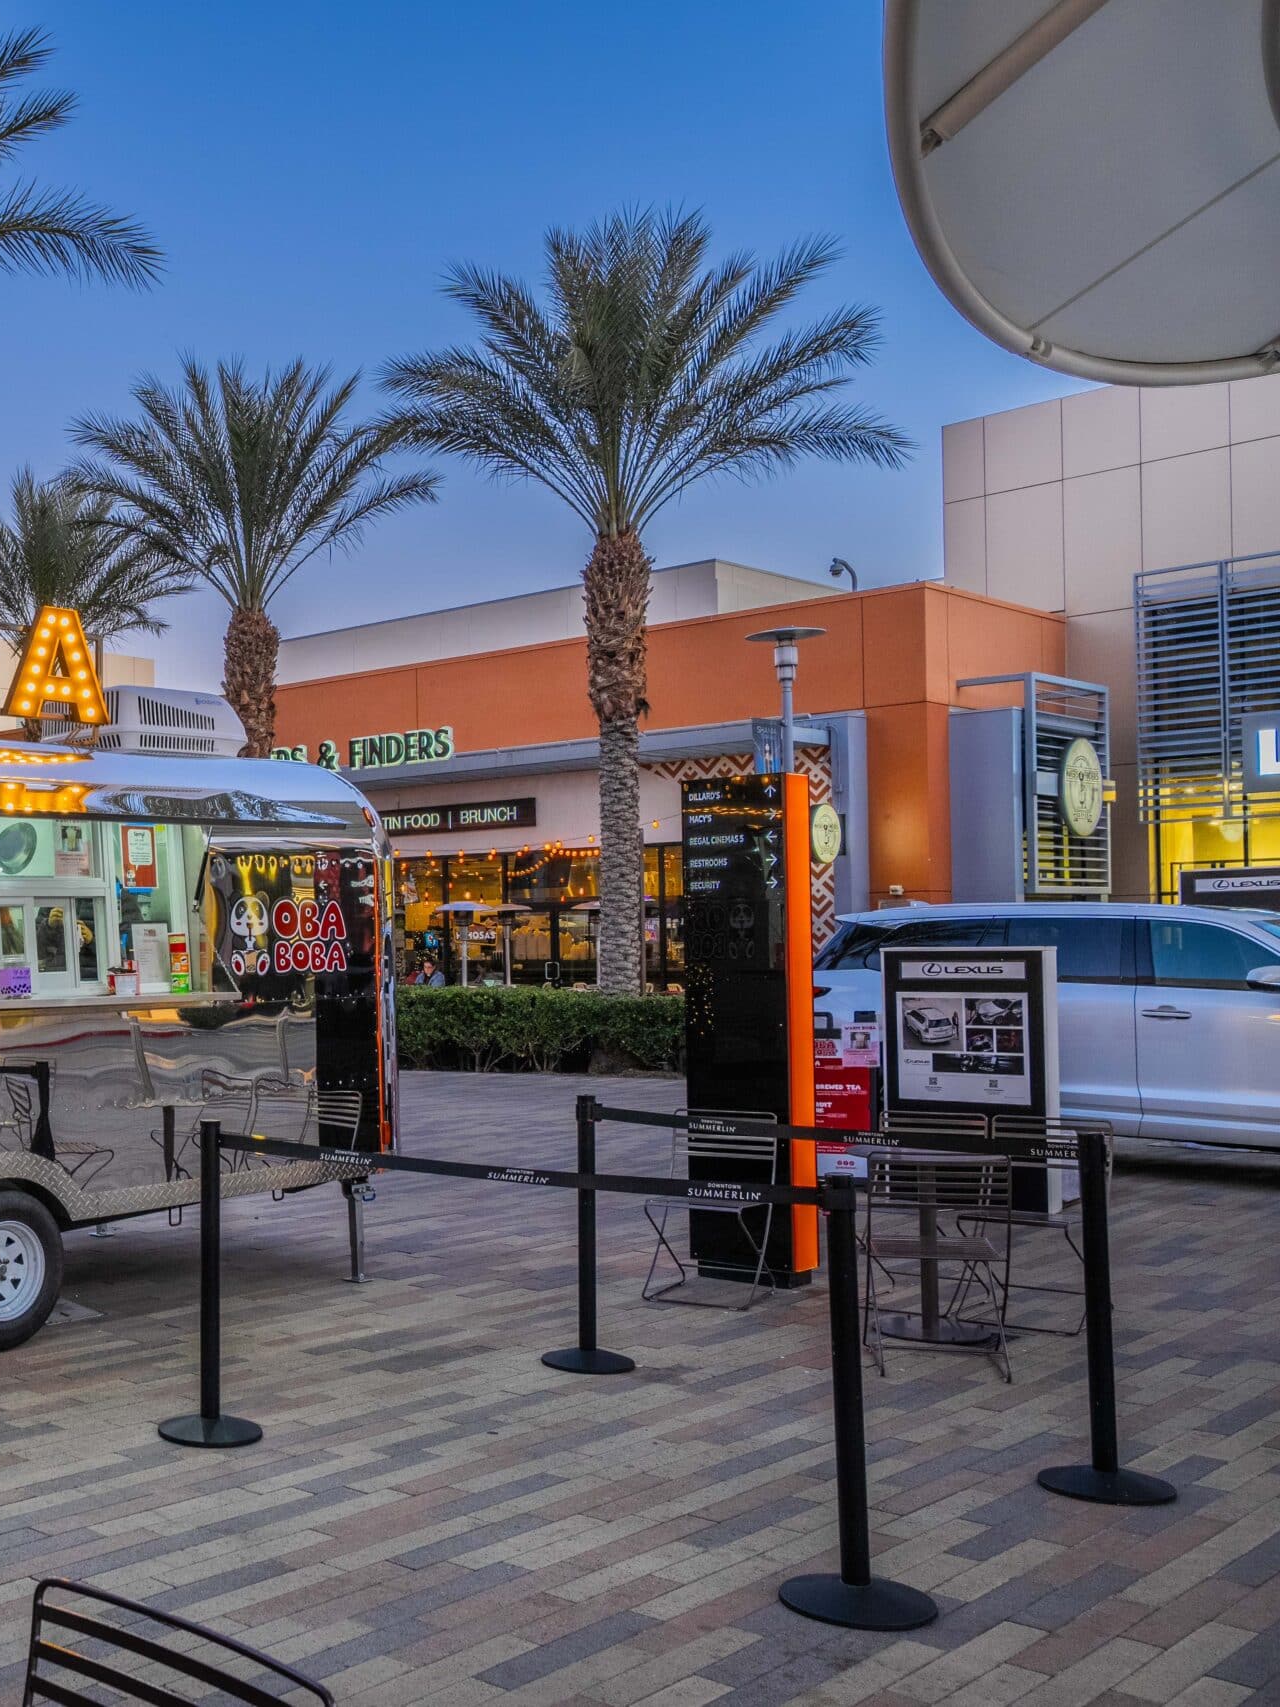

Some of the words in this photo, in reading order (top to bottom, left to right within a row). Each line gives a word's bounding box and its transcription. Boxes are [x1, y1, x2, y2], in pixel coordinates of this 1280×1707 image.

[317, 739, 341, 772] &
[348, 725, 454, 771] FINDERS
[688, 791, 721, 802] DILLARD'S
[382, 816, 401, 830] TIN
[404, 813, 440, 829] FOOD
[460, 806, 517, 825] BRUNCH
[689, 814, 713, 824] MACY'S
[689, 837, 711, 846] REGAL
[711, 835, 738, 844] CINEMAS
[690, 858, 728, 868] RESTROOMS
[690, 881, 721, 891] SECURITY
[272, 899, 347, 941] OBA
[274, 940, 347, 973] BOBA
[945, 966, 1004, 974] LEXUS
[688, 1122, 736, 1133] SUMMERLIN
[843, 1135, 900, 1146] SUMMERLIN
[1030, 1148, 1078, 1158] SUMMER
[319, 1152, 372, 1166] SUMMERLIN
[487, 1171, 550, 1185] SUMMERLIN
[687, 1187, 761, 1201] SUMMERLIN
